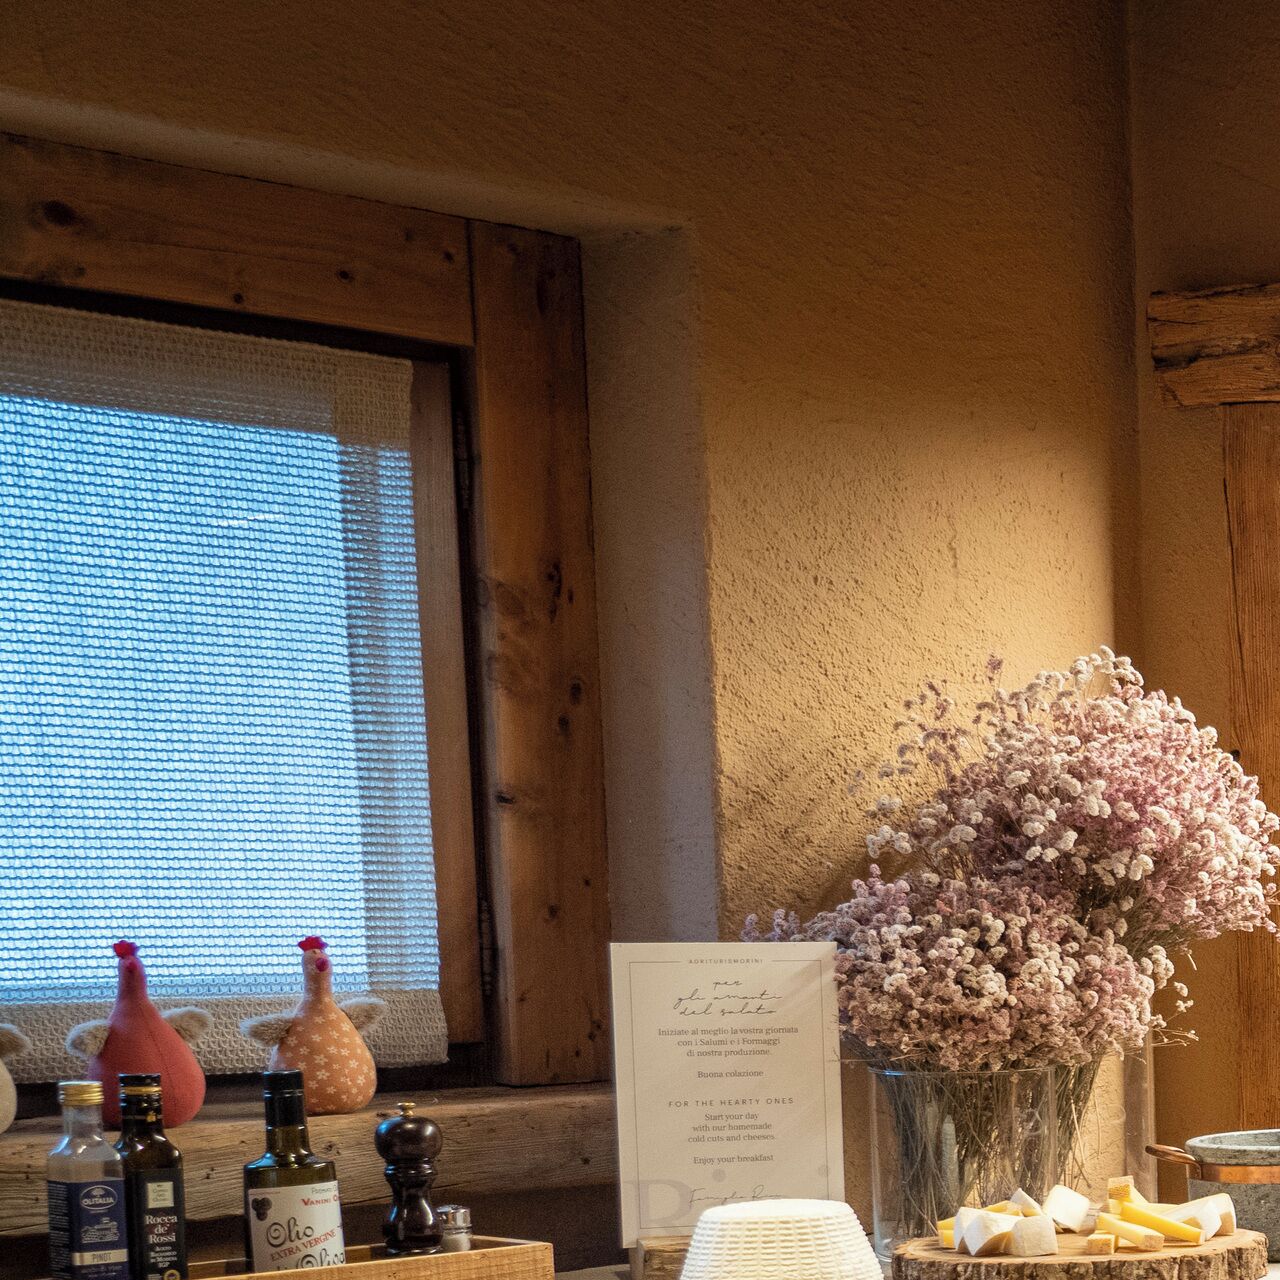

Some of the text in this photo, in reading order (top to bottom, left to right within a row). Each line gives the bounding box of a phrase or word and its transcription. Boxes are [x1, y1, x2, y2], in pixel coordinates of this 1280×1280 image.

[673, 988, 783, 1009] gli amanti
[679, 1002, 777, 1016] del salato
[658, 1027, 689, 1036] Iniziate
[700, 1027, 729, 1037] meglio
[738, 1027, 764, 1035] vostra
[765, 1026, 799, 1036] giornata
[677, 1039, 693, 1047] con
[699, 1038, 728, 1046] Salumi
[742, 1037, 781, 1047] Formaggi
[697, 1069, 764, 1078] Buona colazione
[668, 1097, 794, 1108] FOR THE HEARTY ONES
[704, 1112, 759, 1122] Start your day
[692, 1122, 772, 1132] with our homemade
[688, 1135, 705, 1143] cold
[693, 1154, 774, 1165] Enjoy your breakfast
[145, 1215, 178, 1225] Rocca
[266, 1217, 314, 1248] Olio
[149, 1233, 176, 1244] Rossi
[270, 1228, 336, 1261] EXTRA VERGINE
